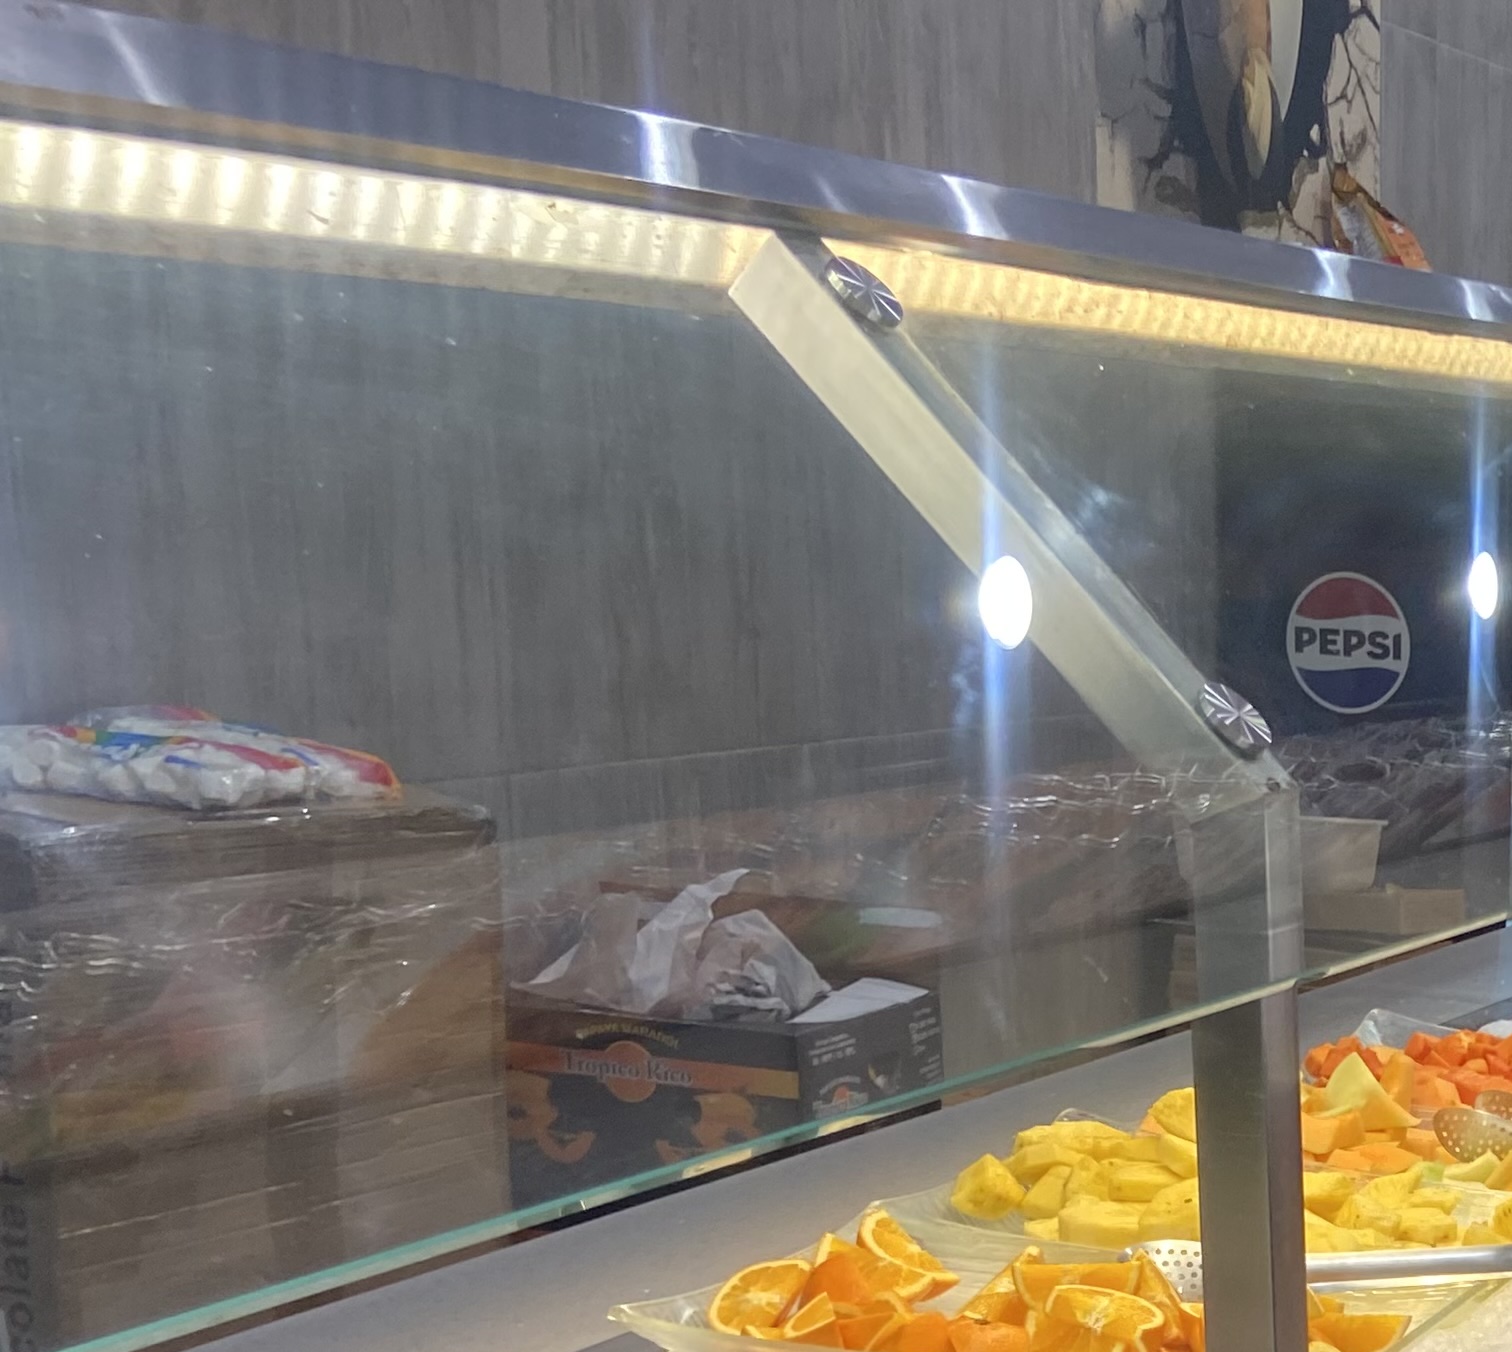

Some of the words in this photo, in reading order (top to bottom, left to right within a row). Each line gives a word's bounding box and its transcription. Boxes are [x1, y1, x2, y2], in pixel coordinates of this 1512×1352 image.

[1294, 626, 1402, 661] PEPSI
[560, 1048, 640, 1082] Tropico
[645, 1057, 694, 1087] Rico
